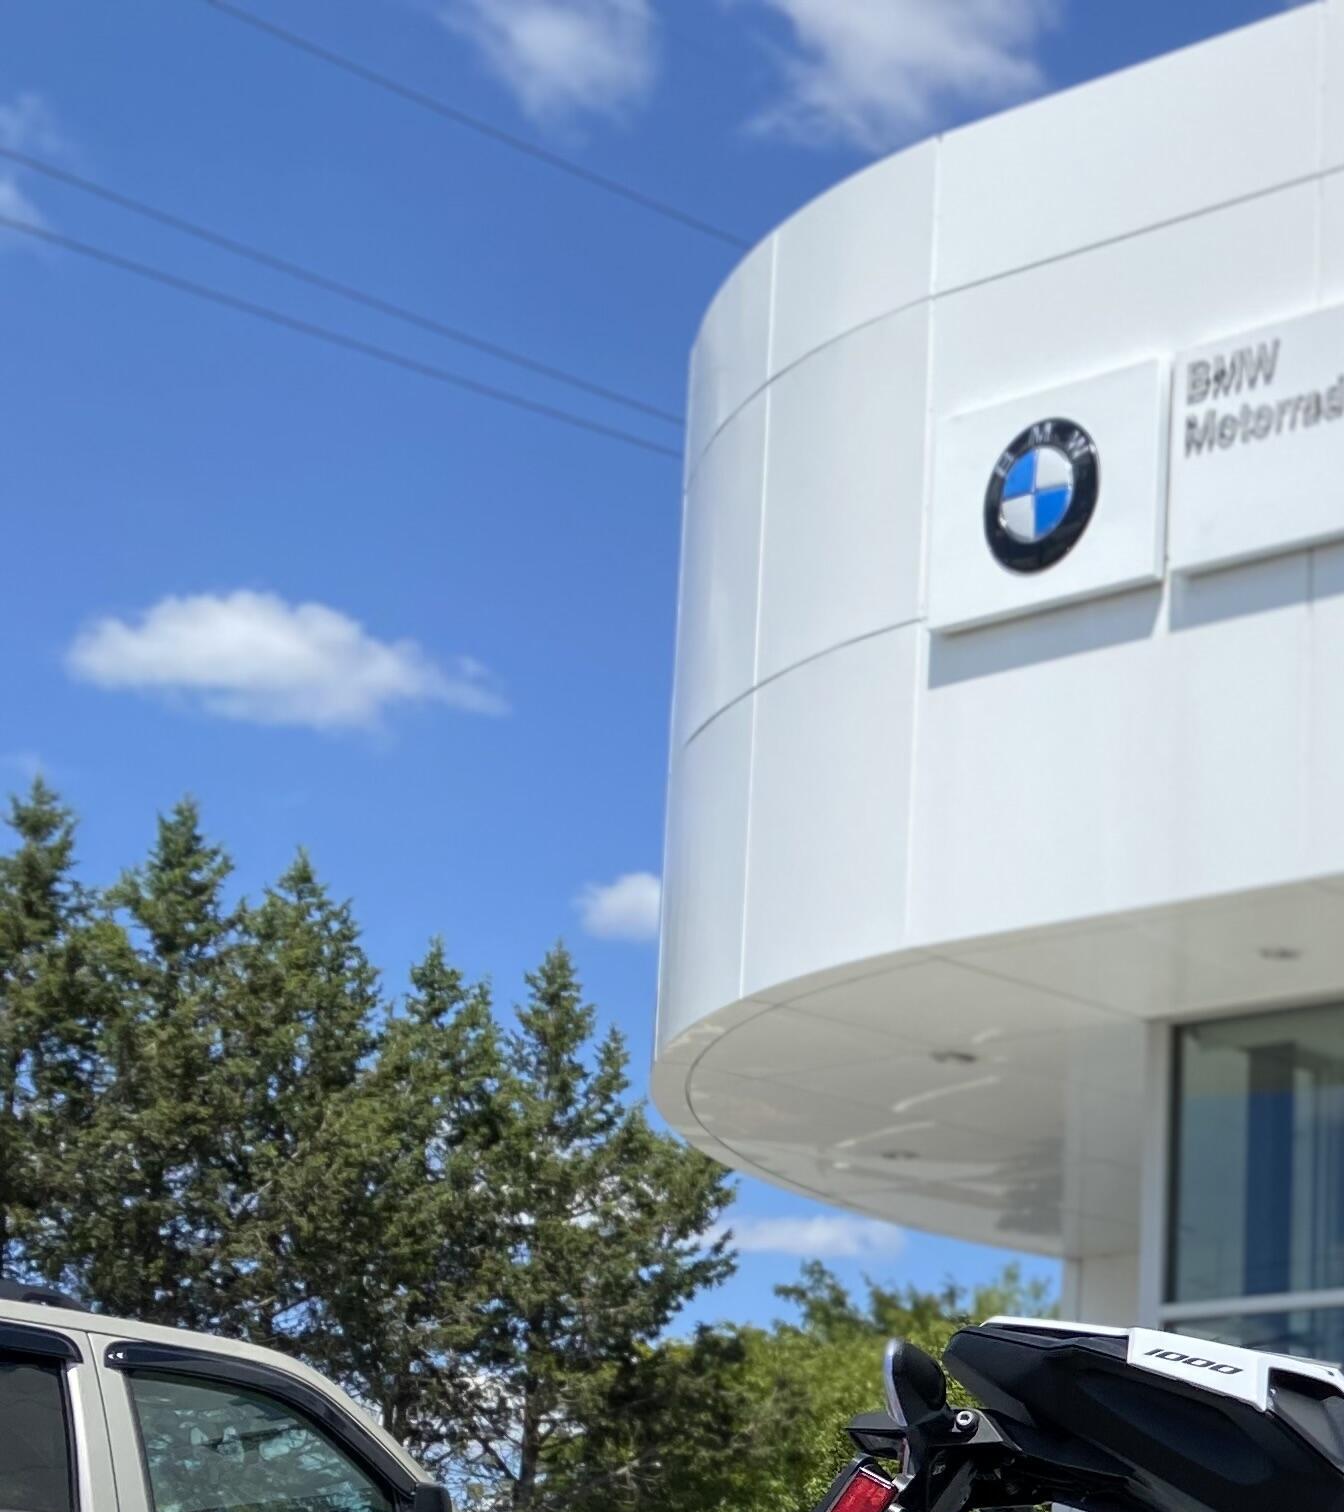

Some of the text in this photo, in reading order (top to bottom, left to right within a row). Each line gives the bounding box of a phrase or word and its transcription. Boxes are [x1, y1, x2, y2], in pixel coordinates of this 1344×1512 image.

[1187, 339, 1281, 404] BMW
[994, 422, 1093, 477] BMW
[1144, 1348, 1243, 1374] 1000
